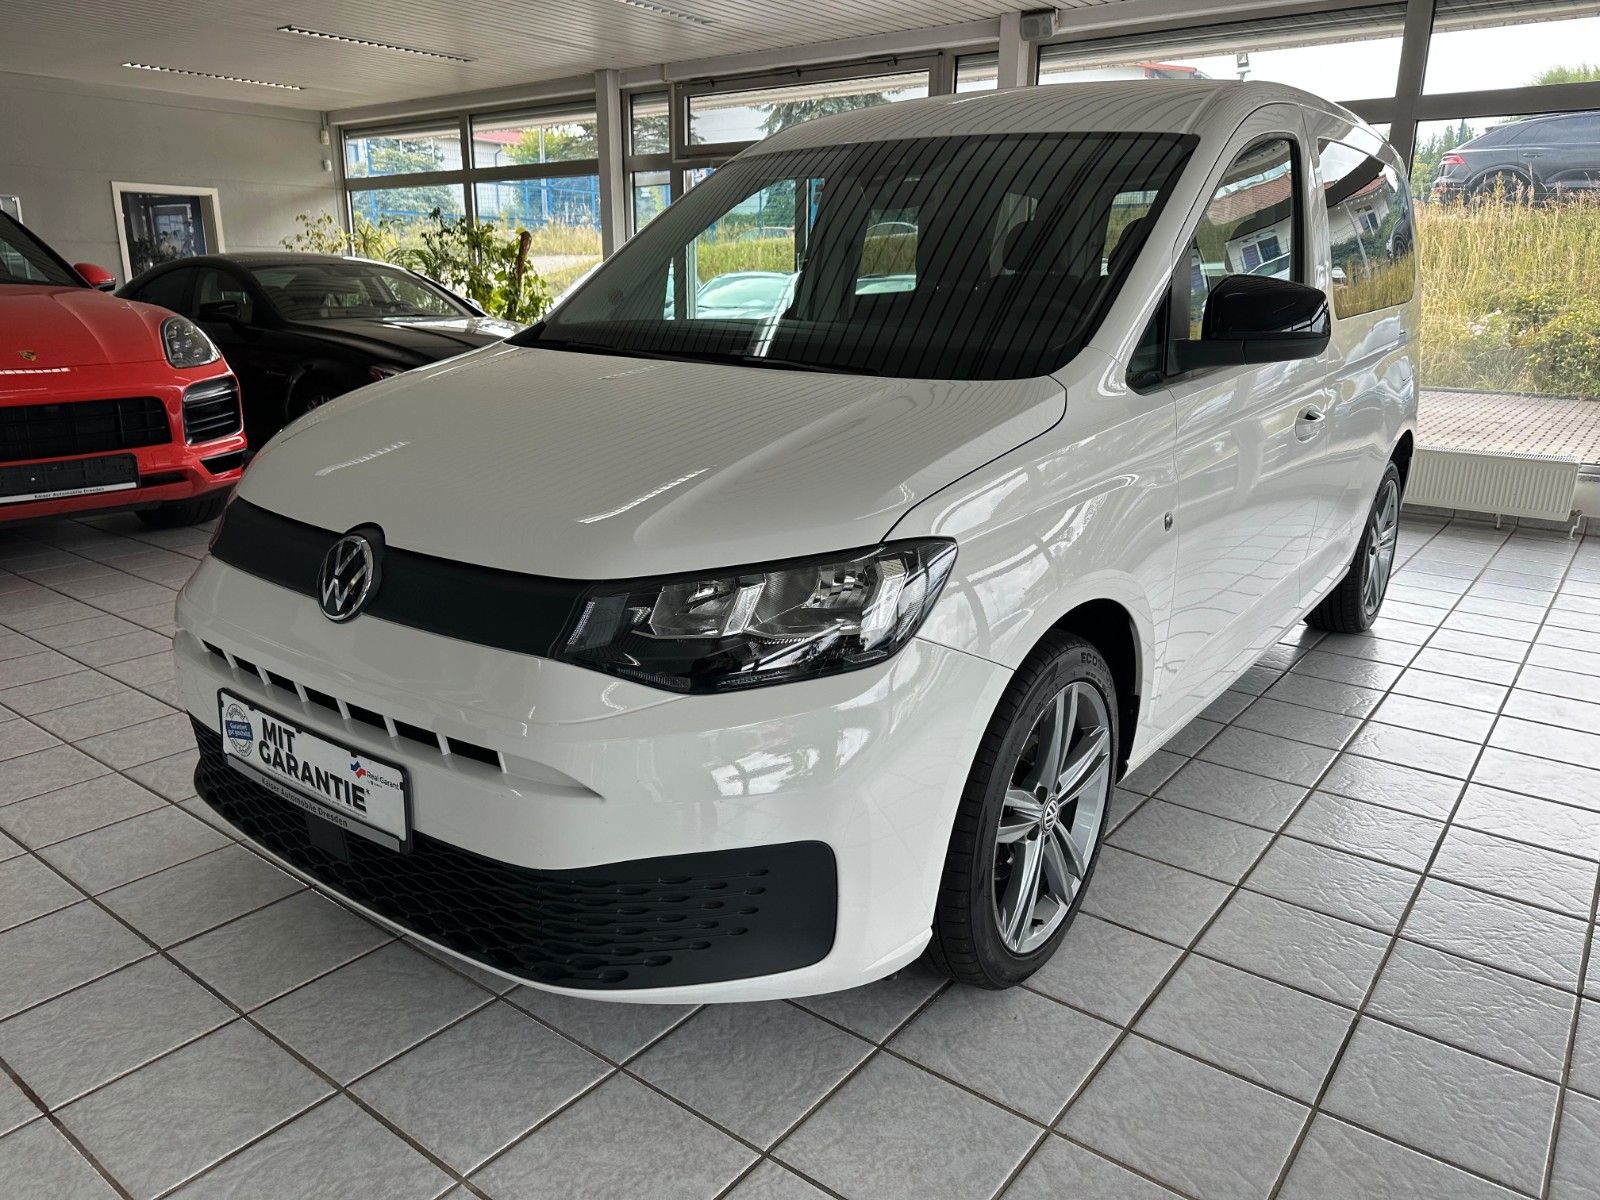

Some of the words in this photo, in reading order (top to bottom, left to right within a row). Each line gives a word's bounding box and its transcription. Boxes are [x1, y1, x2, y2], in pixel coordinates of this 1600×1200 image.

[261, 717, 296, 754] MIT
[261, 776, 281, 793] Kaiser
[281, 787, 317, 813] Automobile
[318, 806, 348, 828] Dresden
[379, 776, 400, 791] Garant
